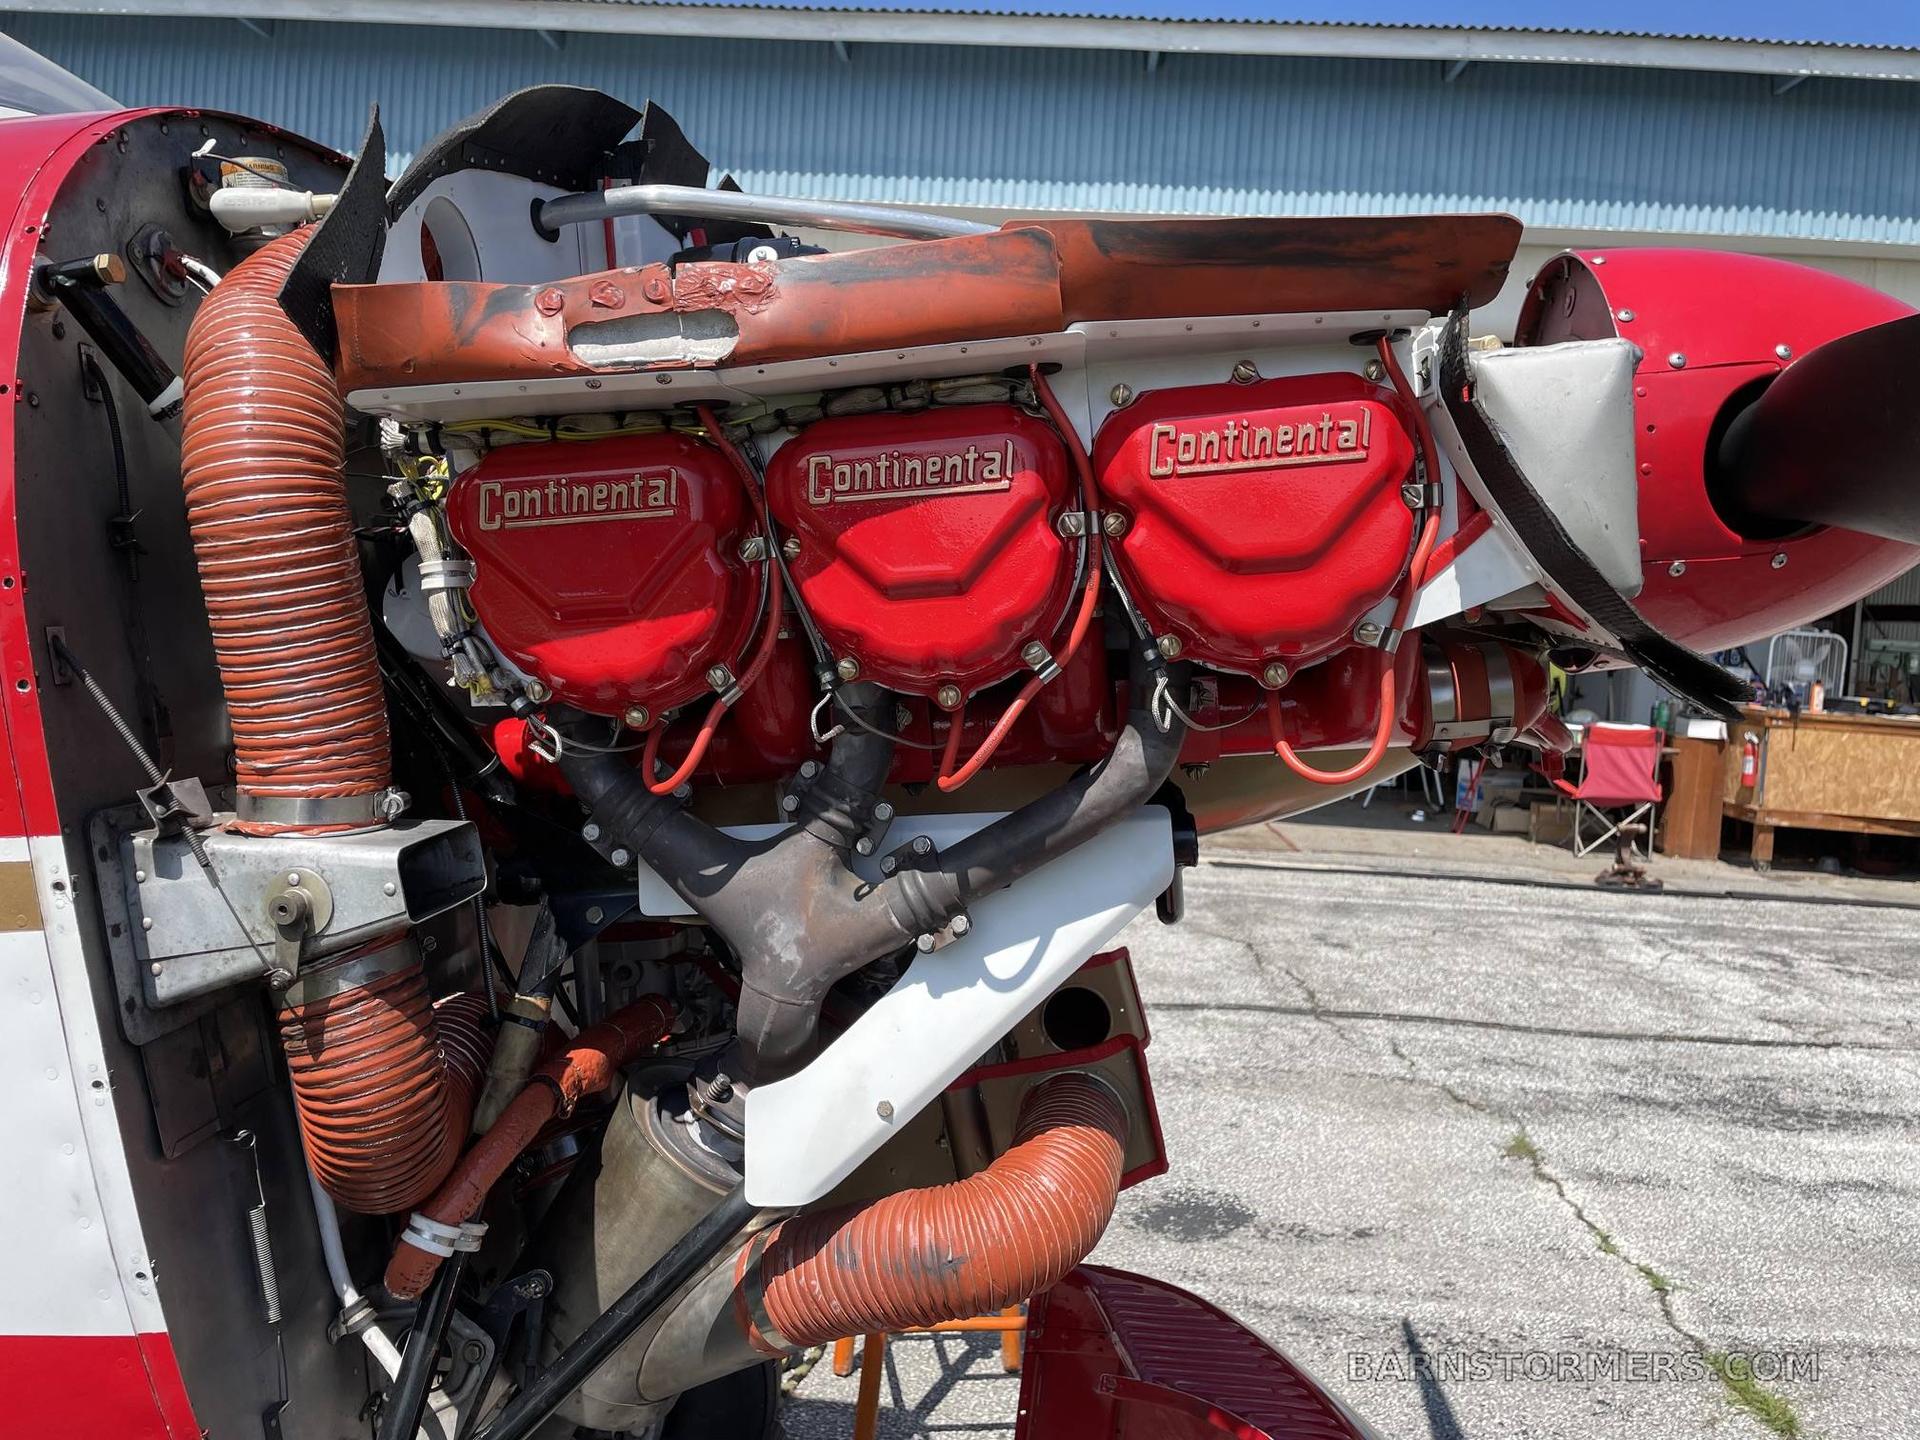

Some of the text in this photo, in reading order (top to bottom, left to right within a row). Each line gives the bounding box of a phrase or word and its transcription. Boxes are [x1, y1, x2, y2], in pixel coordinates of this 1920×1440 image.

[808, 439, 1014, 504] Continental
[1150, 407, 1372, 478] Continental
[479, 467, 678, 531] Continental
